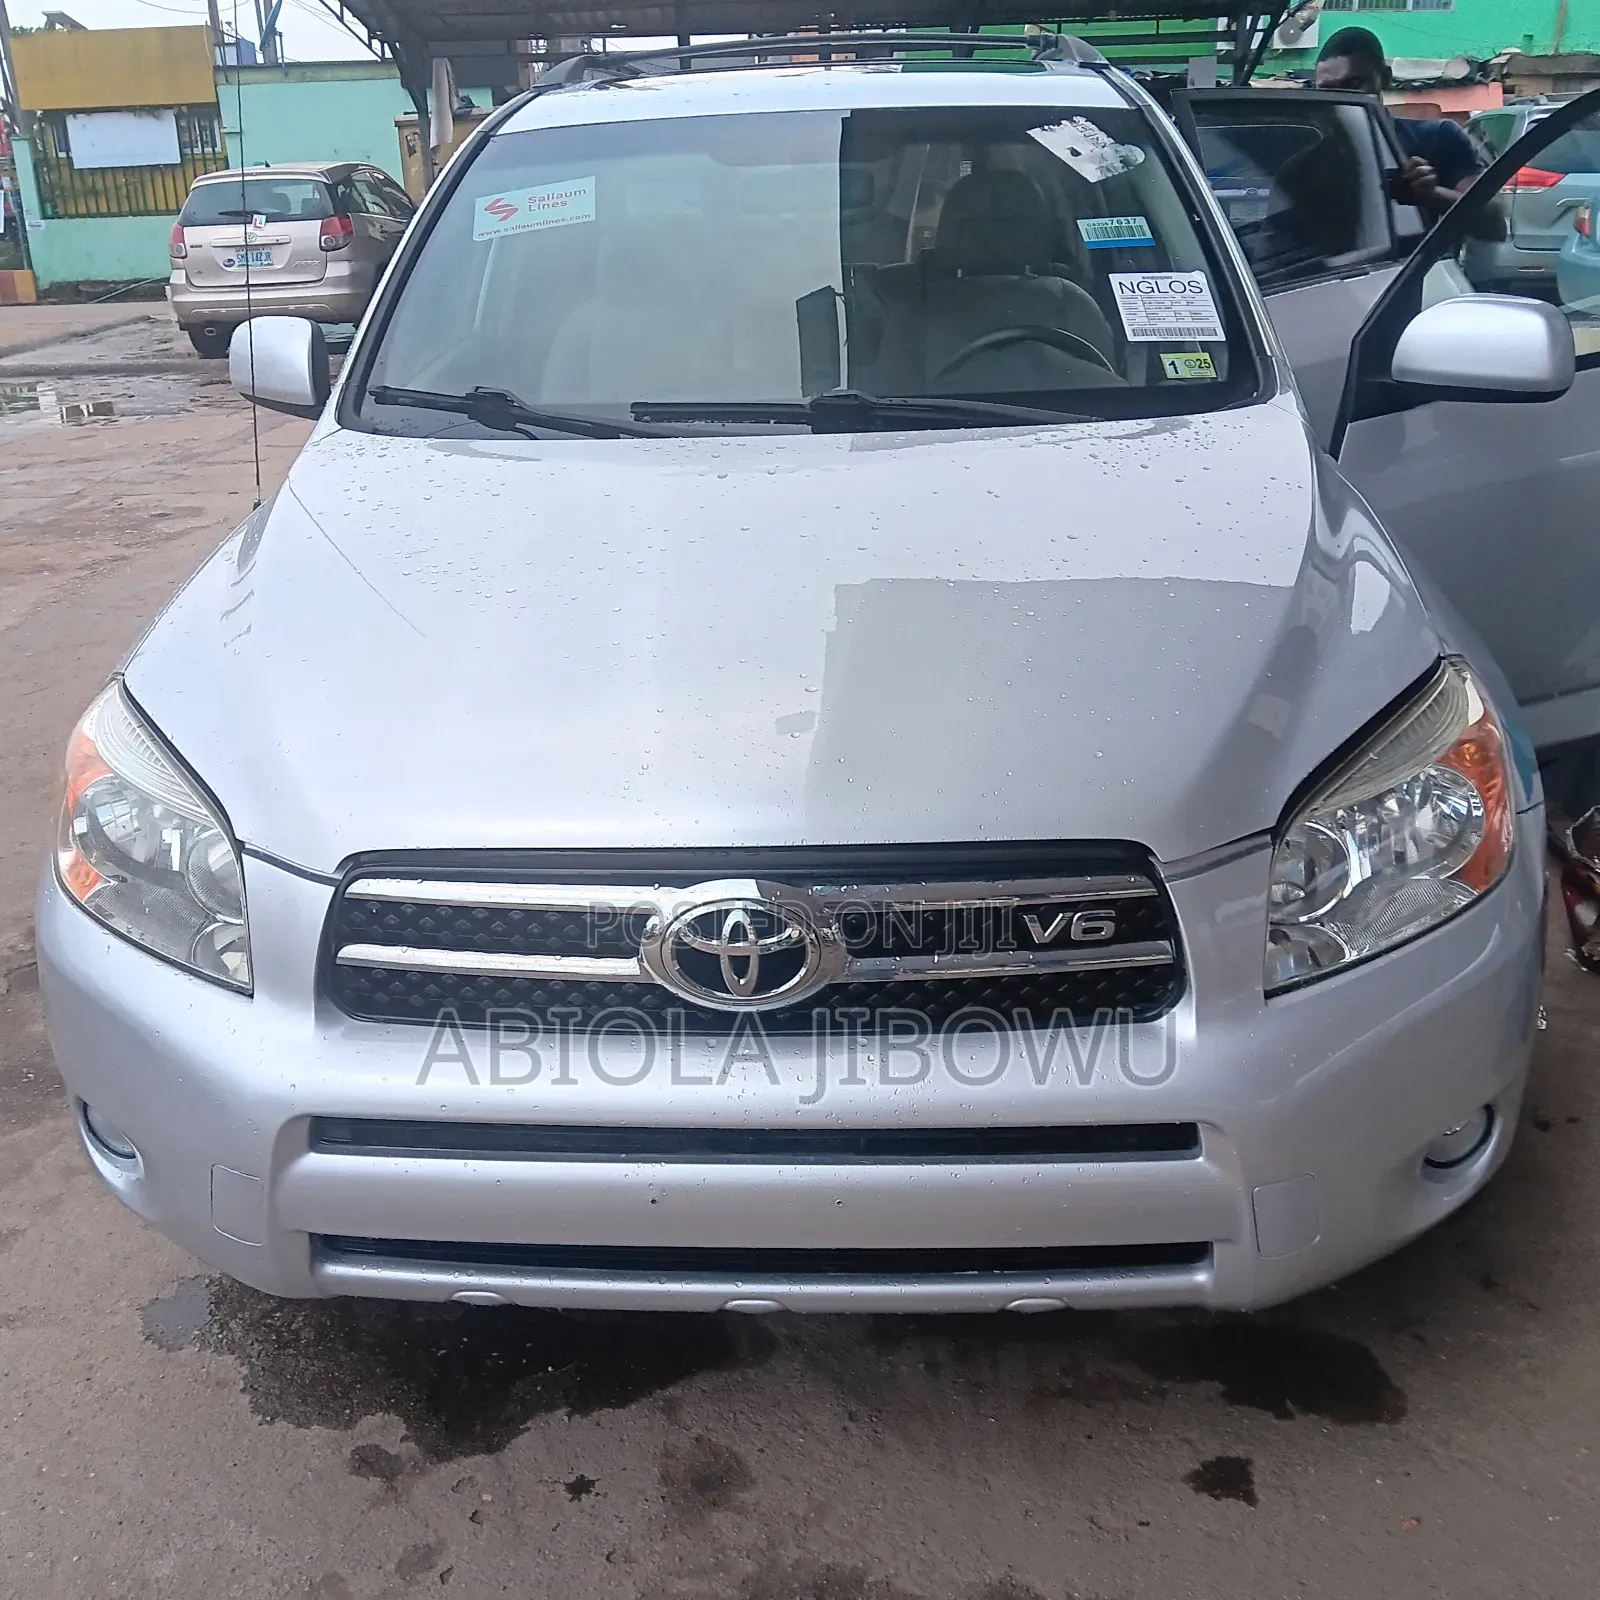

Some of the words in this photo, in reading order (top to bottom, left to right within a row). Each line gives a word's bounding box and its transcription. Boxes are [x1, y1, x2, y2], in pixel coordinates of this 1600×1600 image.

[527, 188, 587, 204] Sallaum
[528, 200, 568, 212] Lines
[477, 213, 591, 237] www.sallaumlines.com
[1118, 280, 1204, 295] NGLOS
[1168, 360, 1180, 375] 1
[1195, 358, 1211, 369] 25
[1019, 909, 1116, 945] V6
